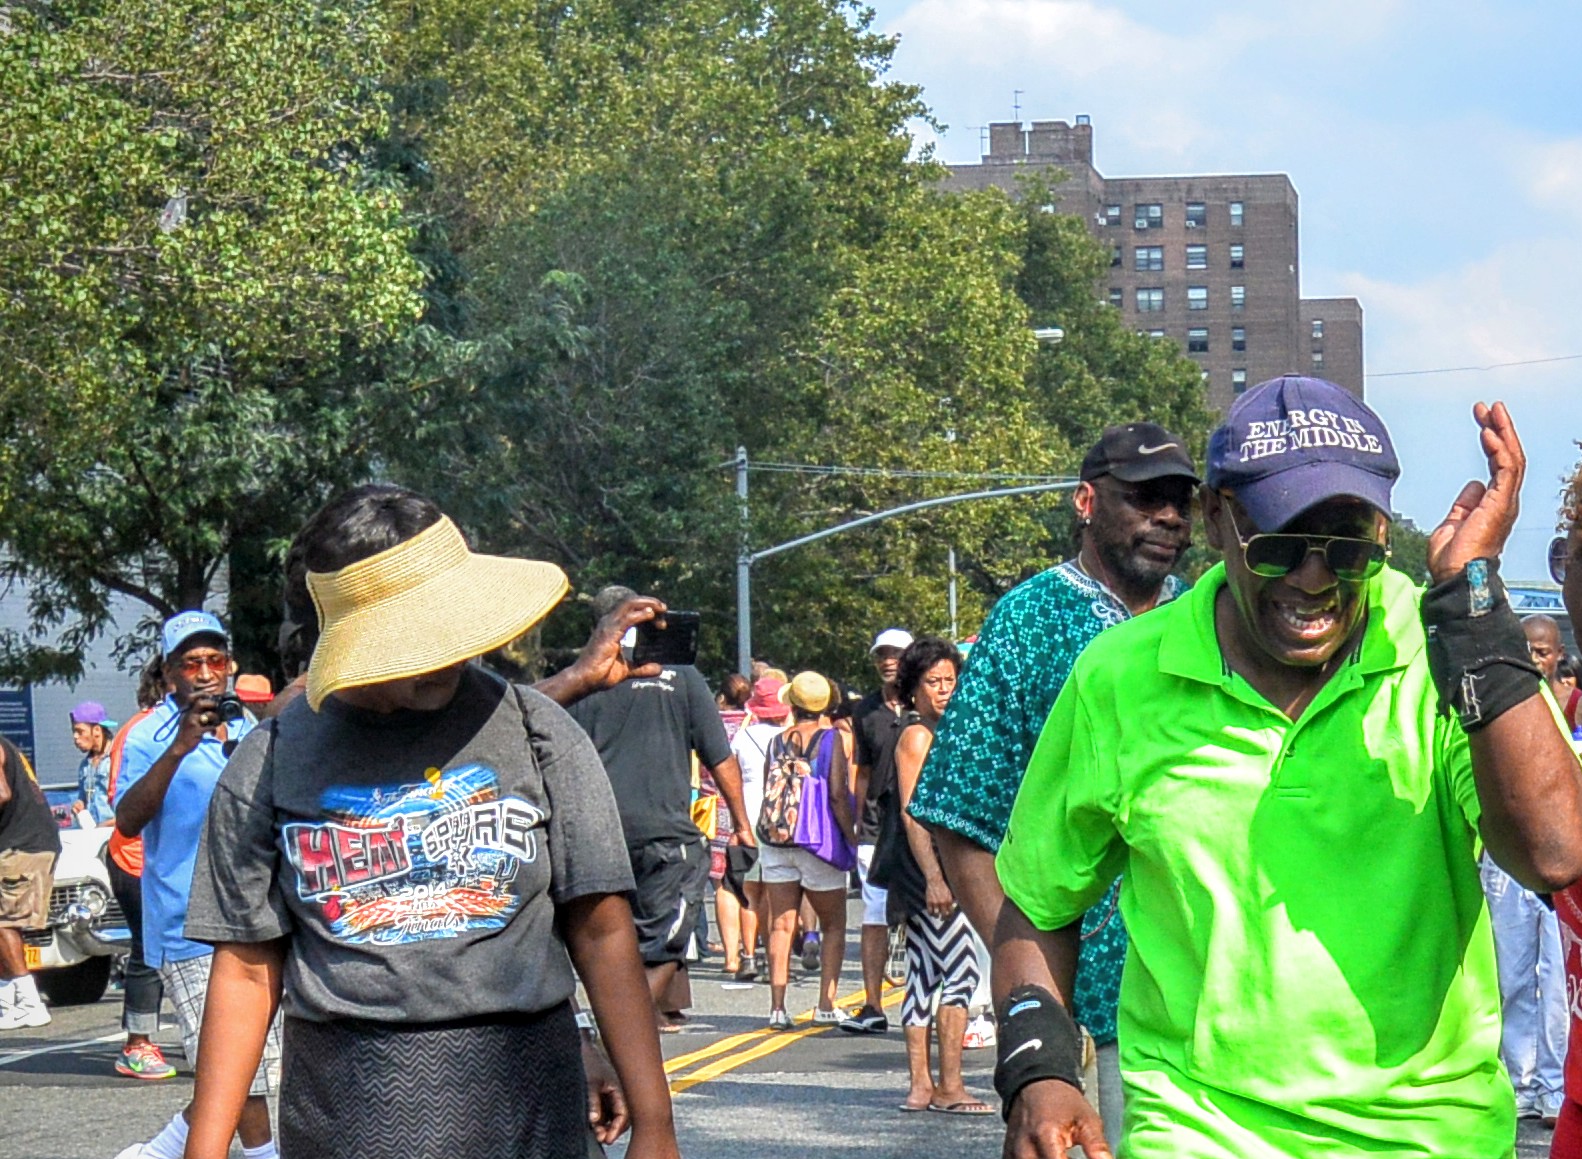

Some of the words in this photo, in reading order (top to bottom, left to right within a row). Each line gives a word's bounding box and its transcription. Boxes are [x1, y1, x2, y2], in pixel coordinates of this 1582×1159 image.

[1246, 409, 1340, 439] ENERGY
[1341, 416, 1366, 433] IN
[1239, 438, 1286, 462] THE
[1290, 427, 1383, 454] MIDDLE
[285, 817, 411, 893] HEAT
[424, 801, 542, 868] SPURS
[400, 882, 447, 899] 2014
